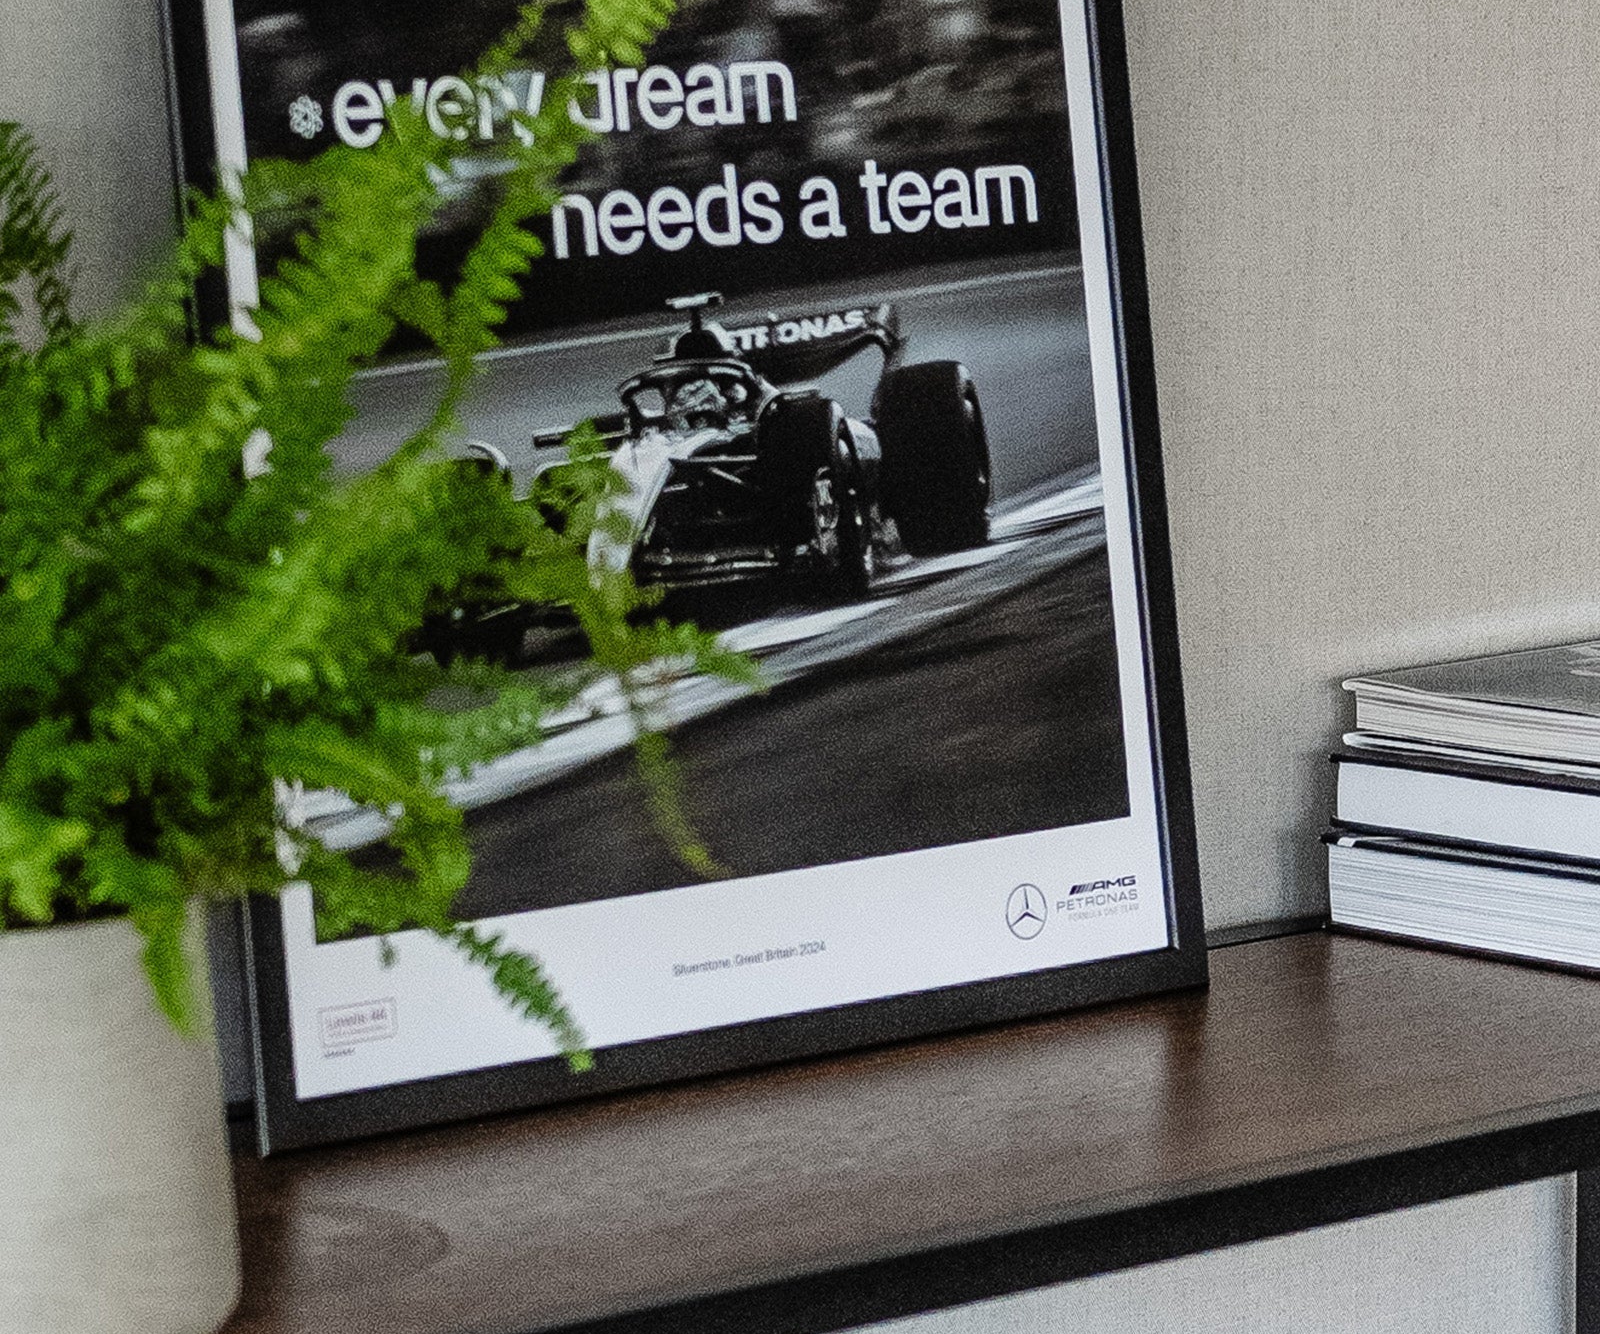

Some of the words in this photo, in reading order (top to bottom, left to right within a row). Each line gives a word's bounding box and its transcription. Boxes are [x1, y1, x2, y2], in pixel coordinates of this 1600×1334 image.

[551, 163, 784, 259] needs
[799, 175, 847, 239] a
[859, 159, 1038, 234] team
[1056, 889, 1138, 913] PETRONAS
